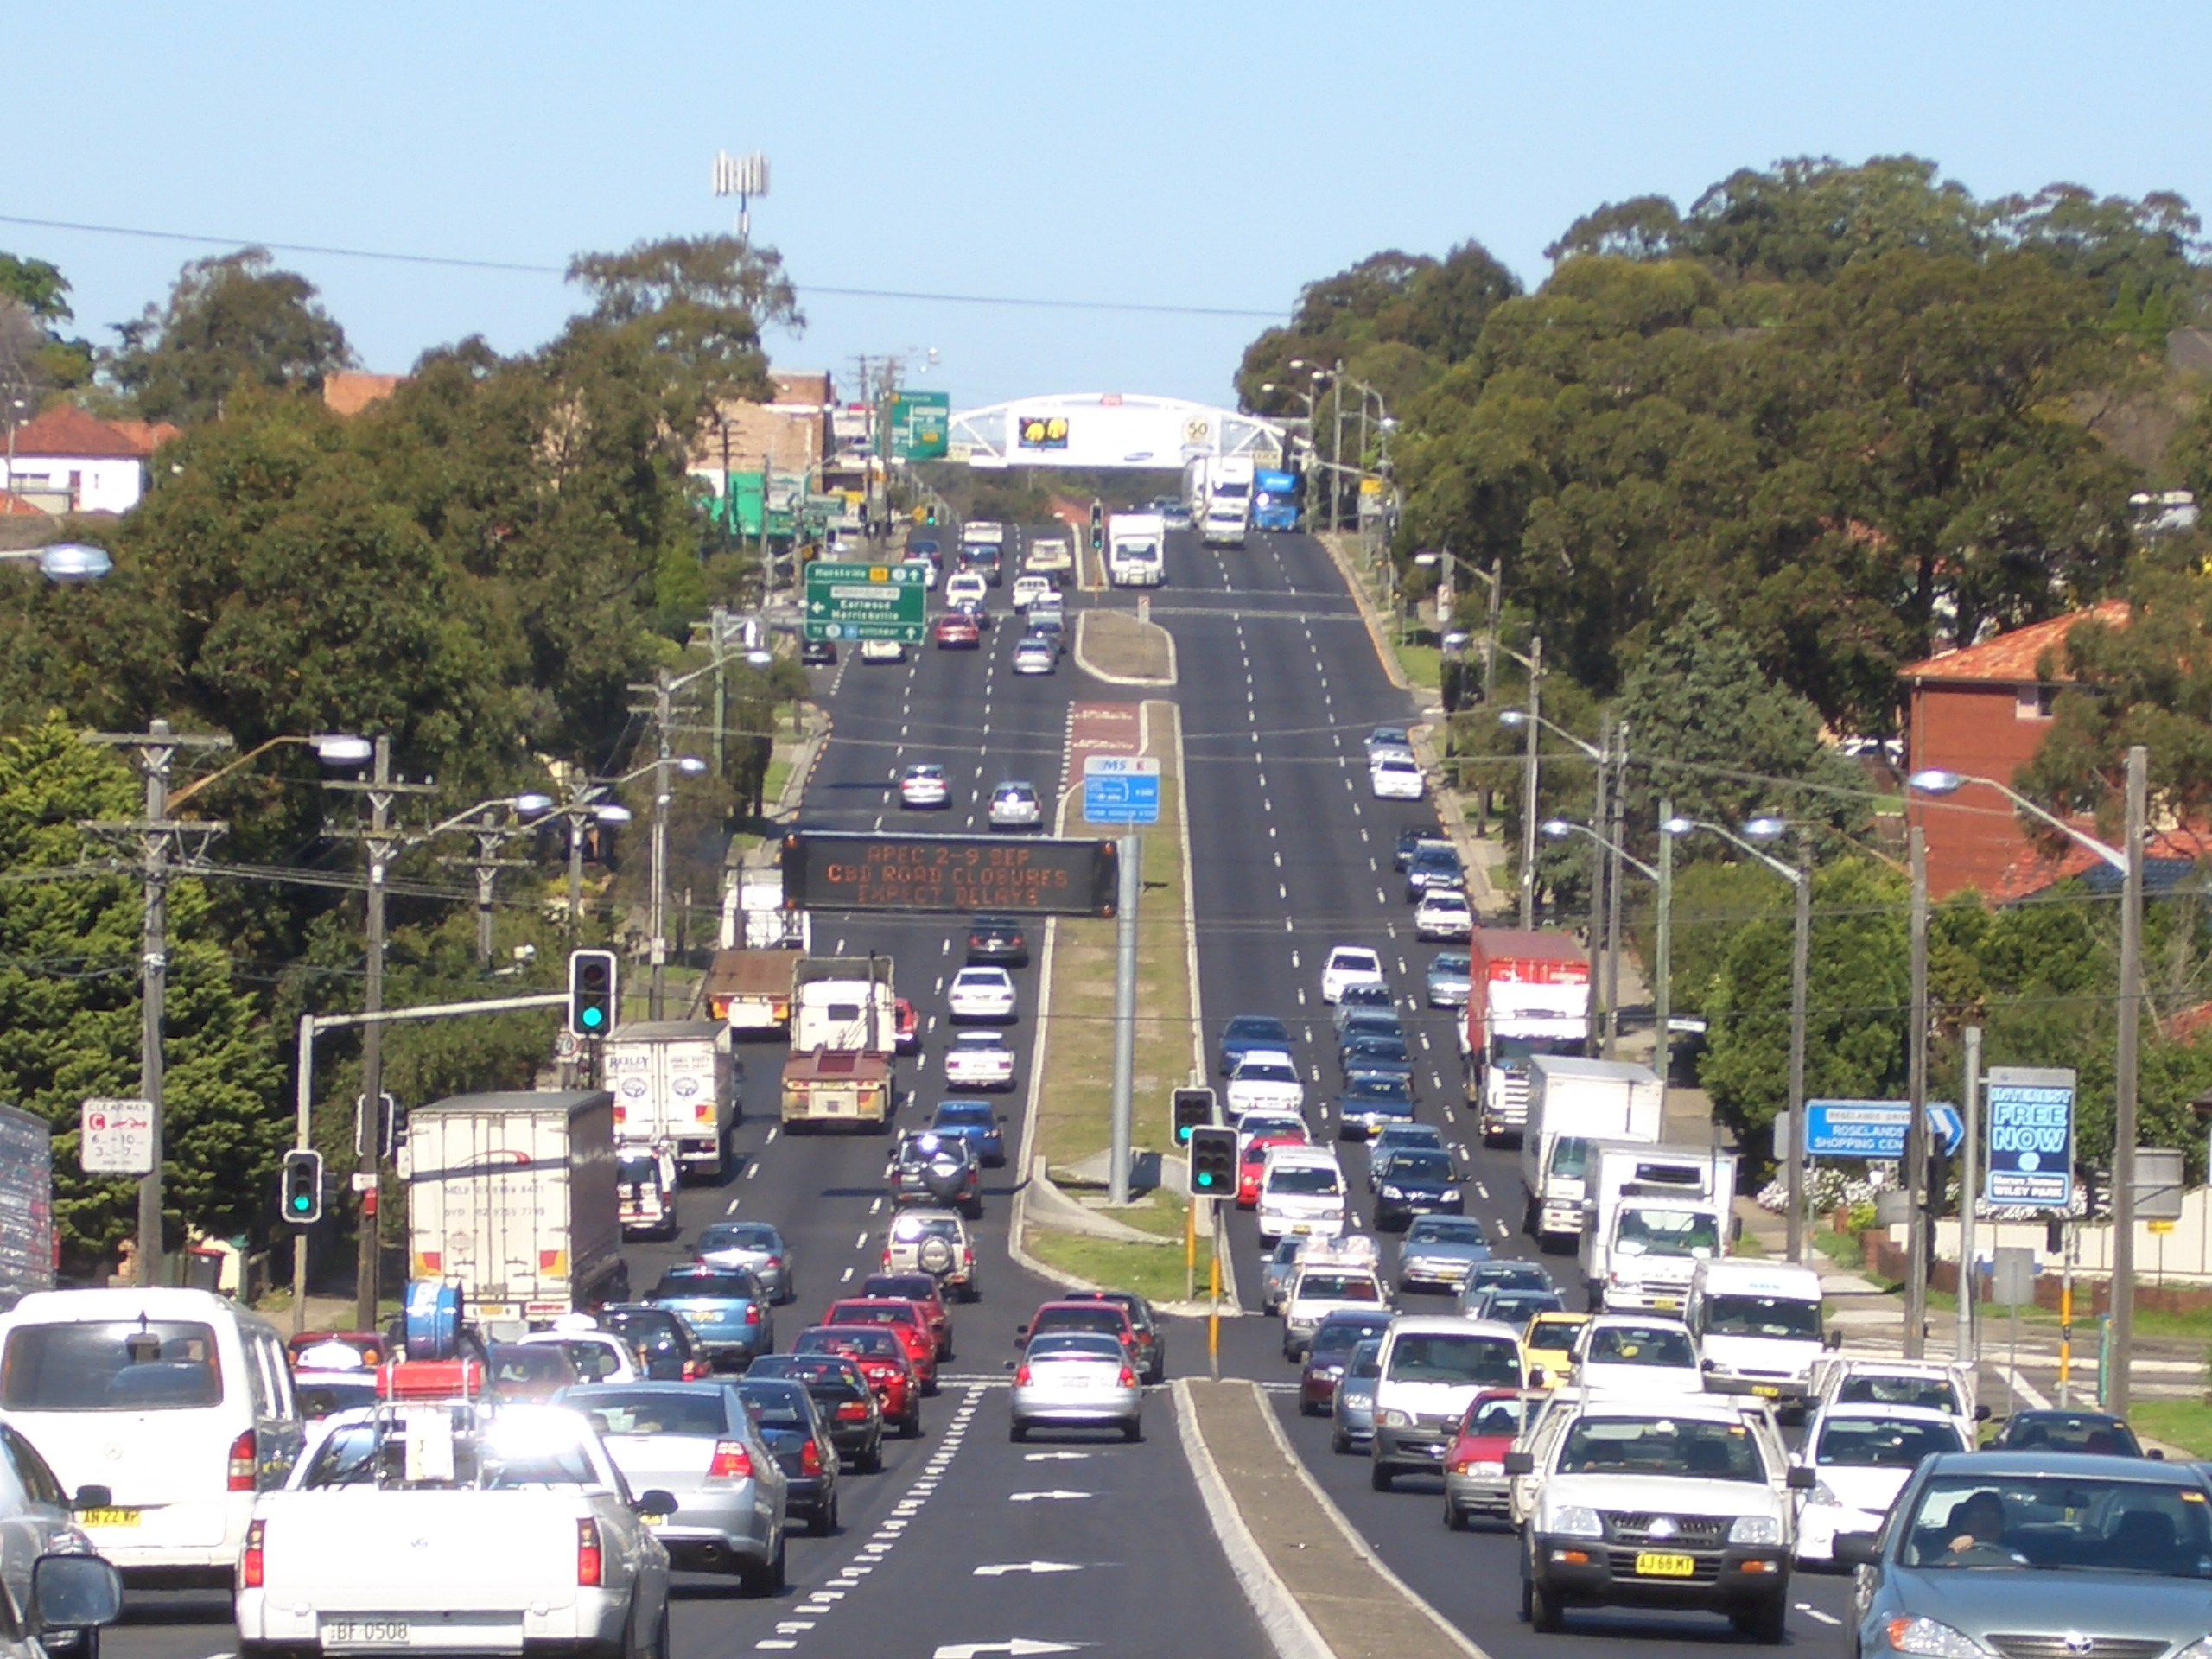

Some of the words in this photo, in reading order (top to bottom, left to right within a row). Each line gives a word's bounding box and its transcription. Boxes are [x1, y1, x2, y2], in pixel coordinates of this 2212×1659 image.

[868, 846, 925, 863] APEC
[936, 848, 979, 864] 2-9
[989, 848, 1032, 865] SEP
[827, 864, 871, 883] CBD
[882, 866, 943, 883] ROAD
[951, 867, 1068, 887] CLOSURES
[858, 884, 942, 904] EXPECT
[955, 886, 1040, 906] DELAYS
[88, 1103, 146, 1112] CLEARWAY
[1886, 1112, 1910, 1121] DRIV
[1993, 1103, 2068, 1127] FREE
[1832, 1125, 1904, 1138] ROSELANDS
[1993, 1126, 2067, 1153] NOW
[1815, 1137, 1875, 1150] SHOPPING
[1878, 1138, 1904, 1149] CEN
[1993, 1185, 2030, 1196] WILEY
[2031, 1187, 2063, 1198] PARK
[338, 1622, 357, 1640] BF
[364, 1622, 408, 1640] 0508
